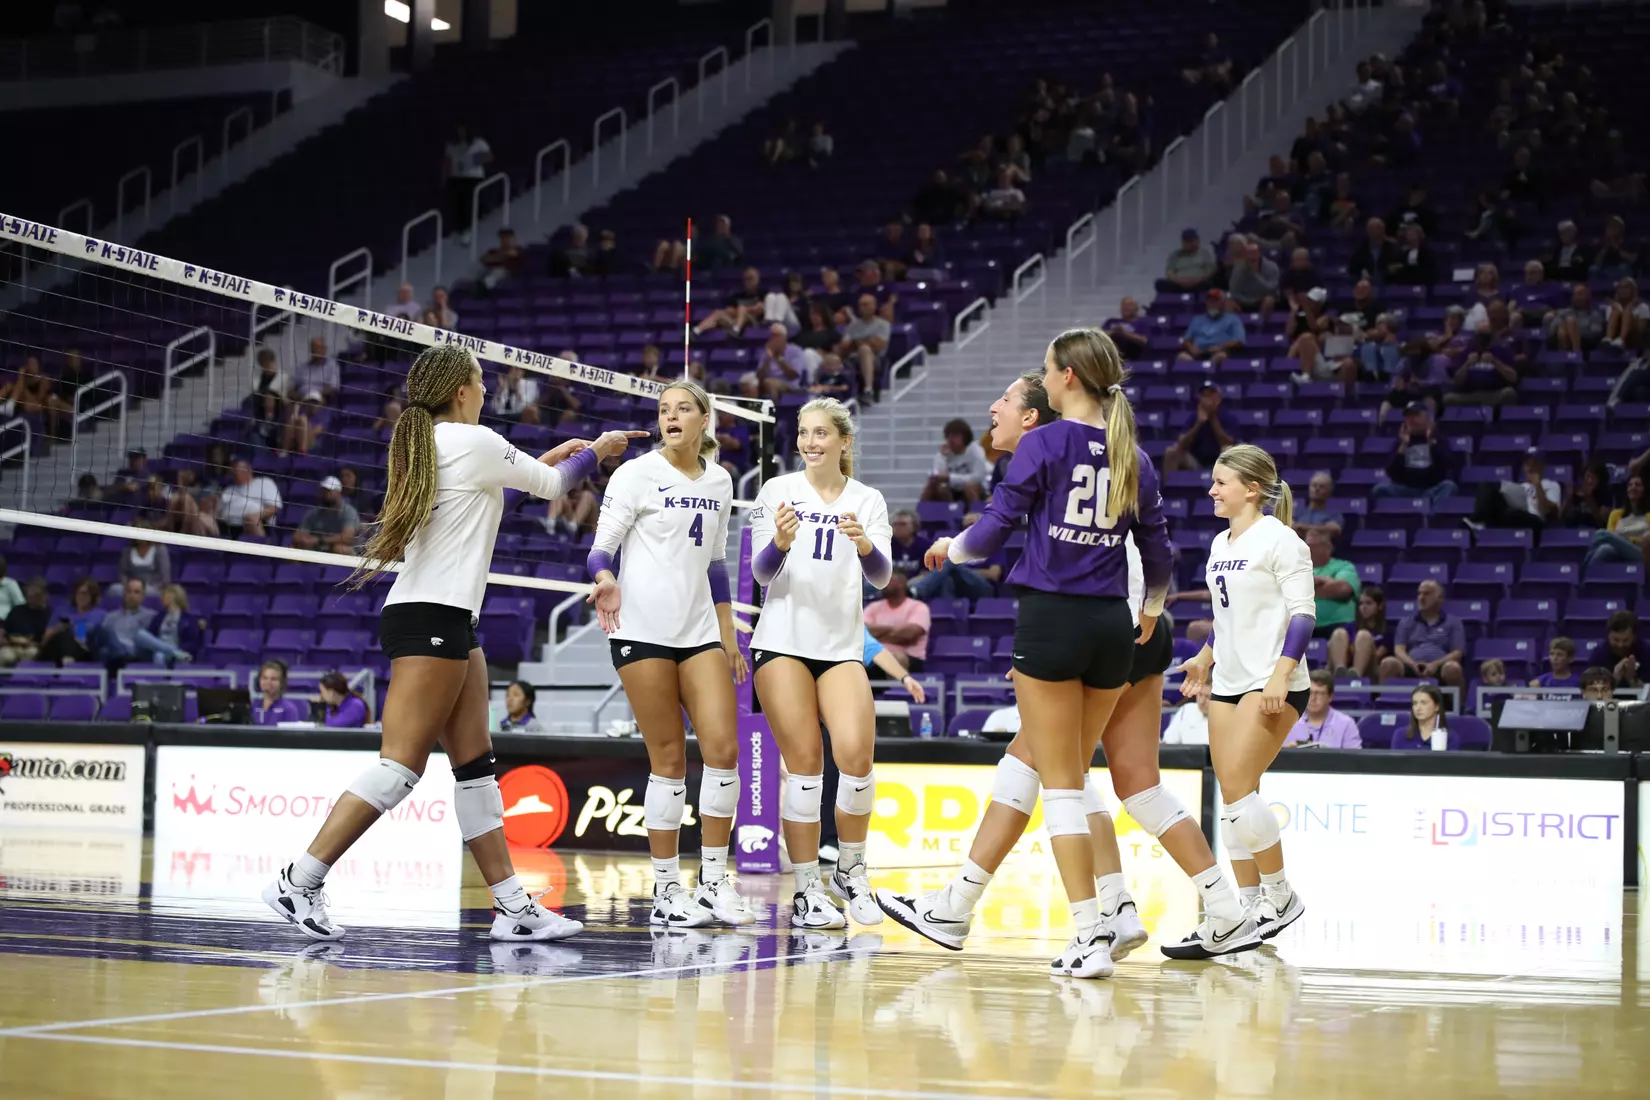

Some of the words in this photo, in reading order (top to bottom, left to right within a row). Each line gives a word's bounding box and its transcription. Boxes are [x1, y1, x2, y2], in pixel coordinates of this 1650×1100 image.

[101, 243, 160, 271] K-STATE
[199, 269, 252, 295] K-STATE
[289, 292, 337, 317] K-STATE
[369, 313, 415, 336] K-STATE
[515, 350, 554, 371] K-STATE
[579, 367, 615, 385] K-STATE
[639, 380, 667, 396] K-STA
[664, 496, 721, 512] K-STATE
[1063, 463, 1120, 530] 20
[688, 512, 704, 547] 4
[794, 510, 850, 525] K-STA
[812, 527, 835, 562] 11
[1048, 523, 1122, 547] WILDCAT
[1215, 574, 1230, 608] 3
[750, 731, 762, 768] sports
[224, 786, 334, 819] SMOOT
[750, 769, 762, 817] imports
[3, 801, 85, 814] PROFESSIONAL
[88, 803, 127, 815] GRADE
[1440, 808, 1621, 842] DISTRICT
